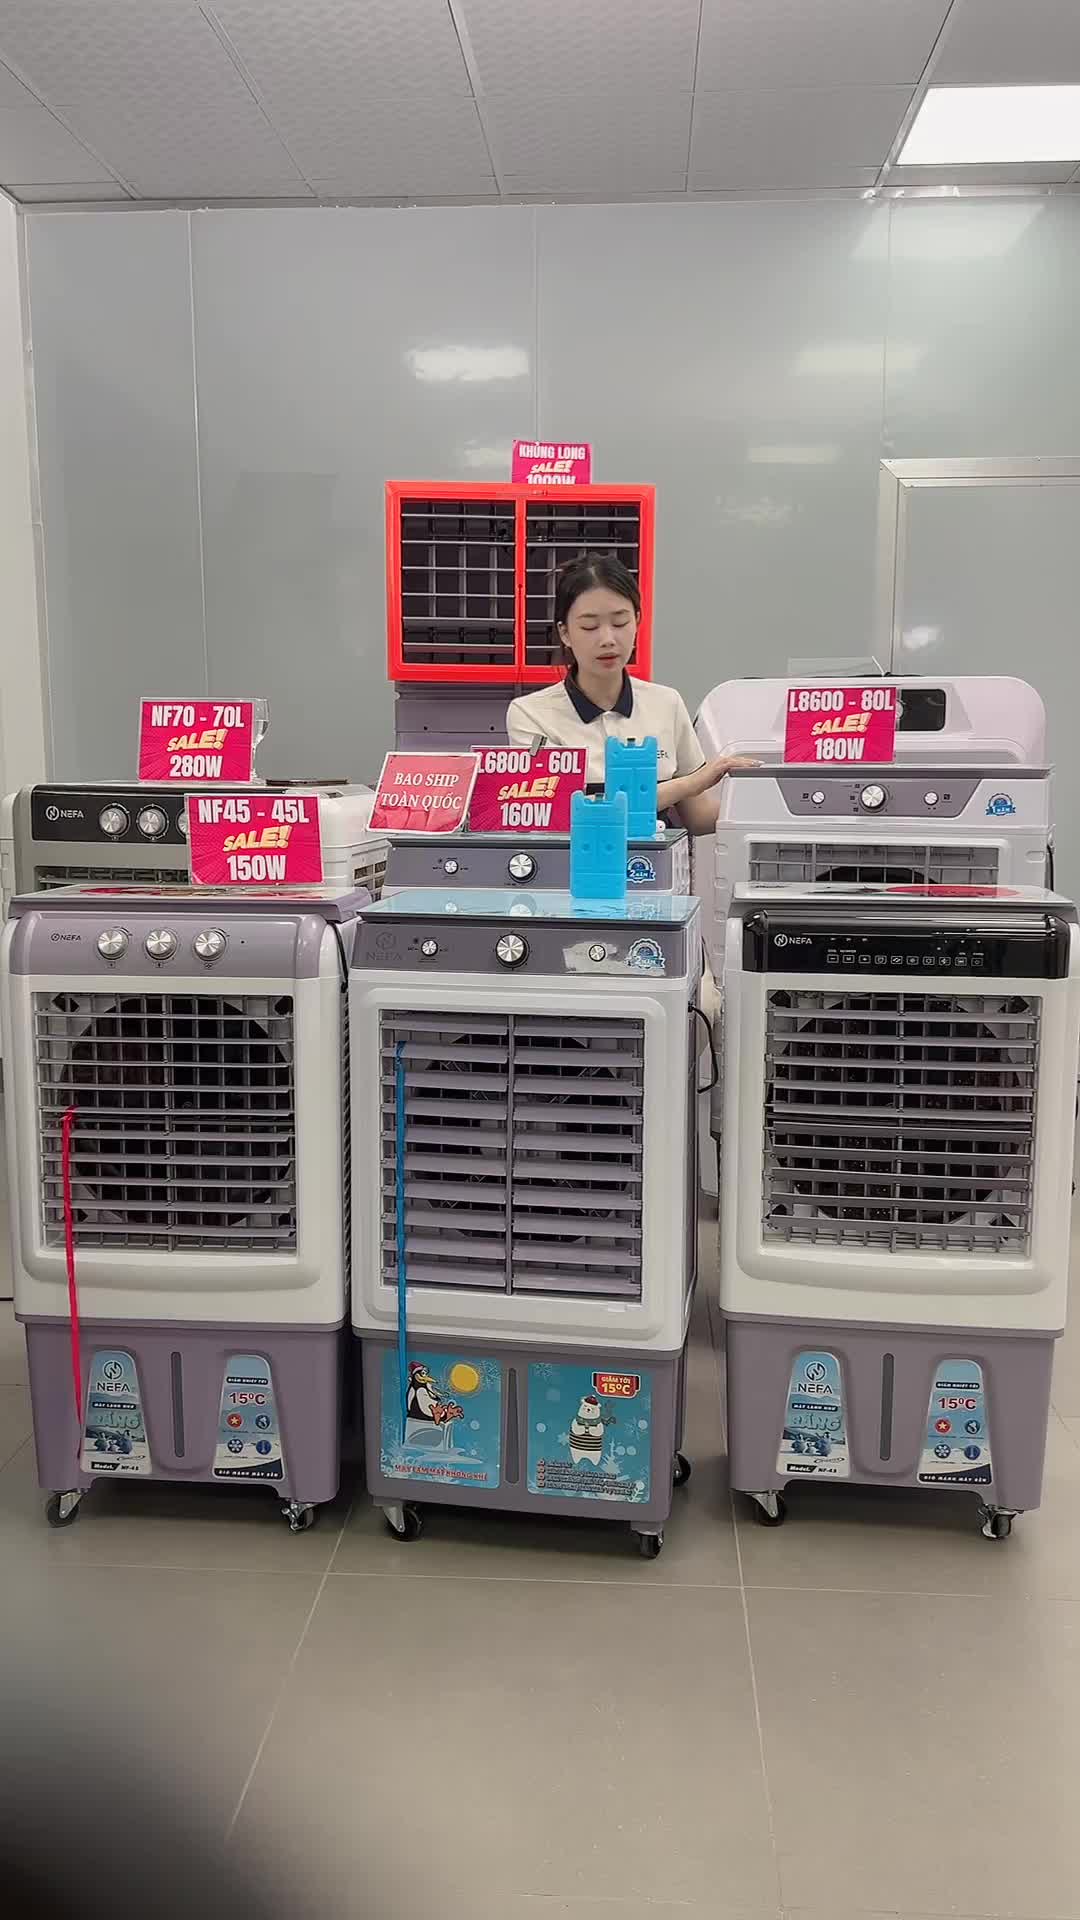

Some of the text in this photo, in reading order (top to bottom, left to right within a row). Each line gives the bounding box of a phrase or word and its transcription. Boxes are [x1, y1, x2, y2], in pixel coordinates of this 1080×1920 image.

[557, 446, 586, 460] LONG
[789, 690, 845, 712] L8600
[861, 689, 894, 711] 80L
[151, 705, 195, 727] NF70
[212, 705, 245, 728] 70L
[814, 737, 865, 761] 180W
[169, 754, 223, 778] 280W
[548, 751, 582, 774] 60L
[393, 772, 459, 787] BAO SHIP
[198, 799, 251, 823] NF45
[271, 799, 310, 823] 45L
[381, 791, 462, 811] TOÀN QUỐC
[60, 810, 84, 818] NEFA
[500, 802, 552, 827] 160W
[226, 854, 287, 881] 150W
[789, 937, 813, 945] NEFA
[97, 1382, 130, 1392] NEFA
[797, 1383, 833, 1394] NEFA
